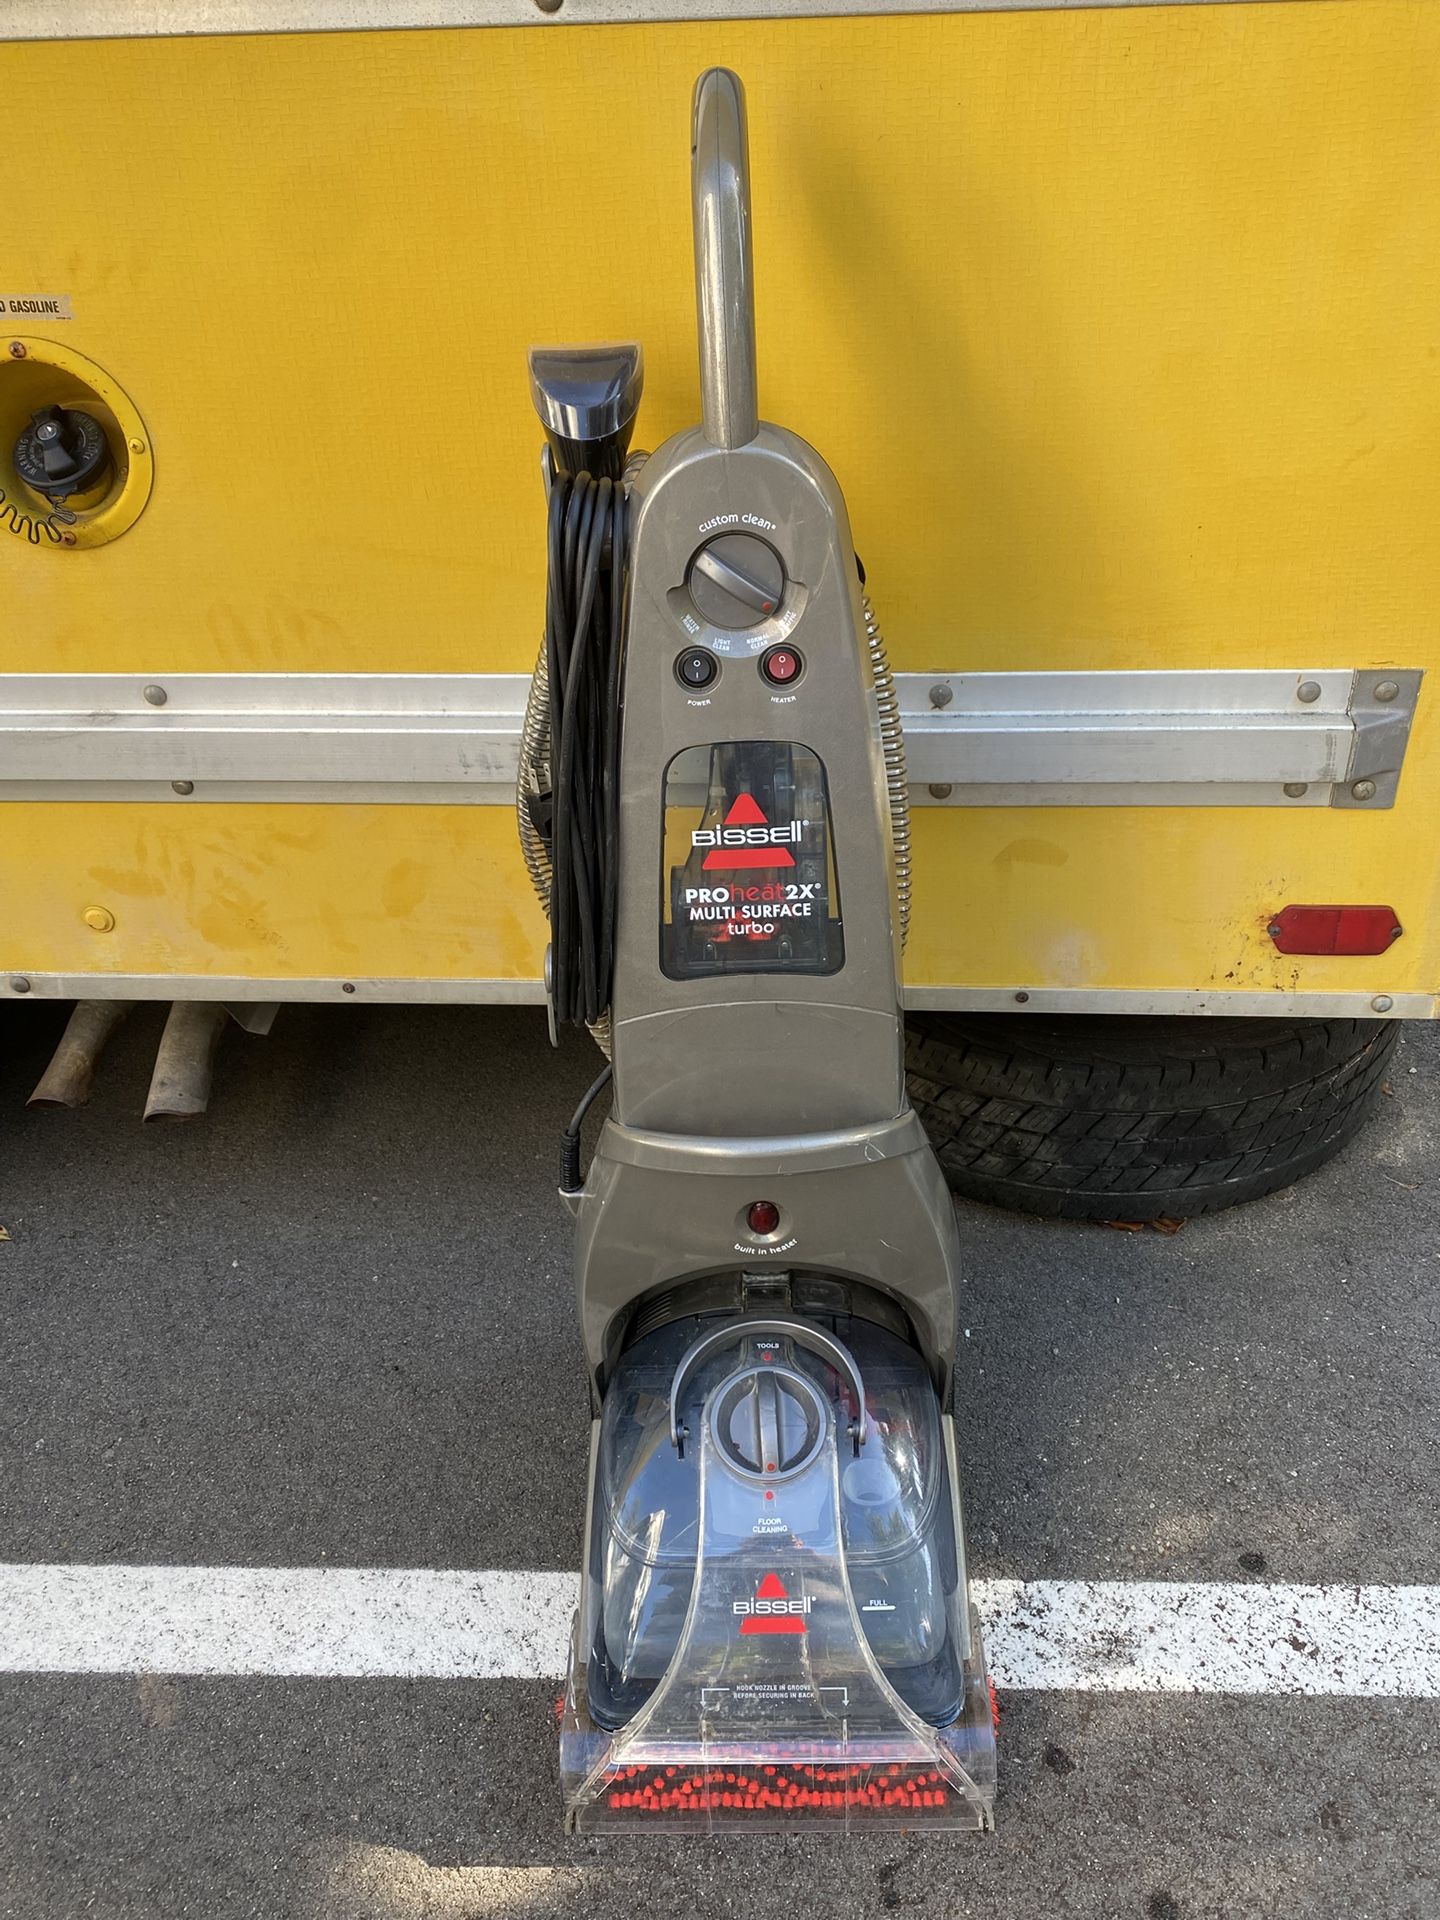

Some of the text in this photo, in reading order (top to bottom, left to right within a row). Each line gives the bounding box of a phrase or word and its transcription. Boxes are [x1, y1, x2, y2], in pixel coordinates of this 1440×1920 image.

[9, 300, 60, 313] GASOLINE
[698, 513, 772, 533] custom clean
[689, 903, 812, 921] MULTI SURFACE
[727, 921, 775, 935] turbo
[734, 1243, 755, 1255] built
[769, 1238, 798, 1254] heater
[752, 1525, 788, 1533] CLEANING
